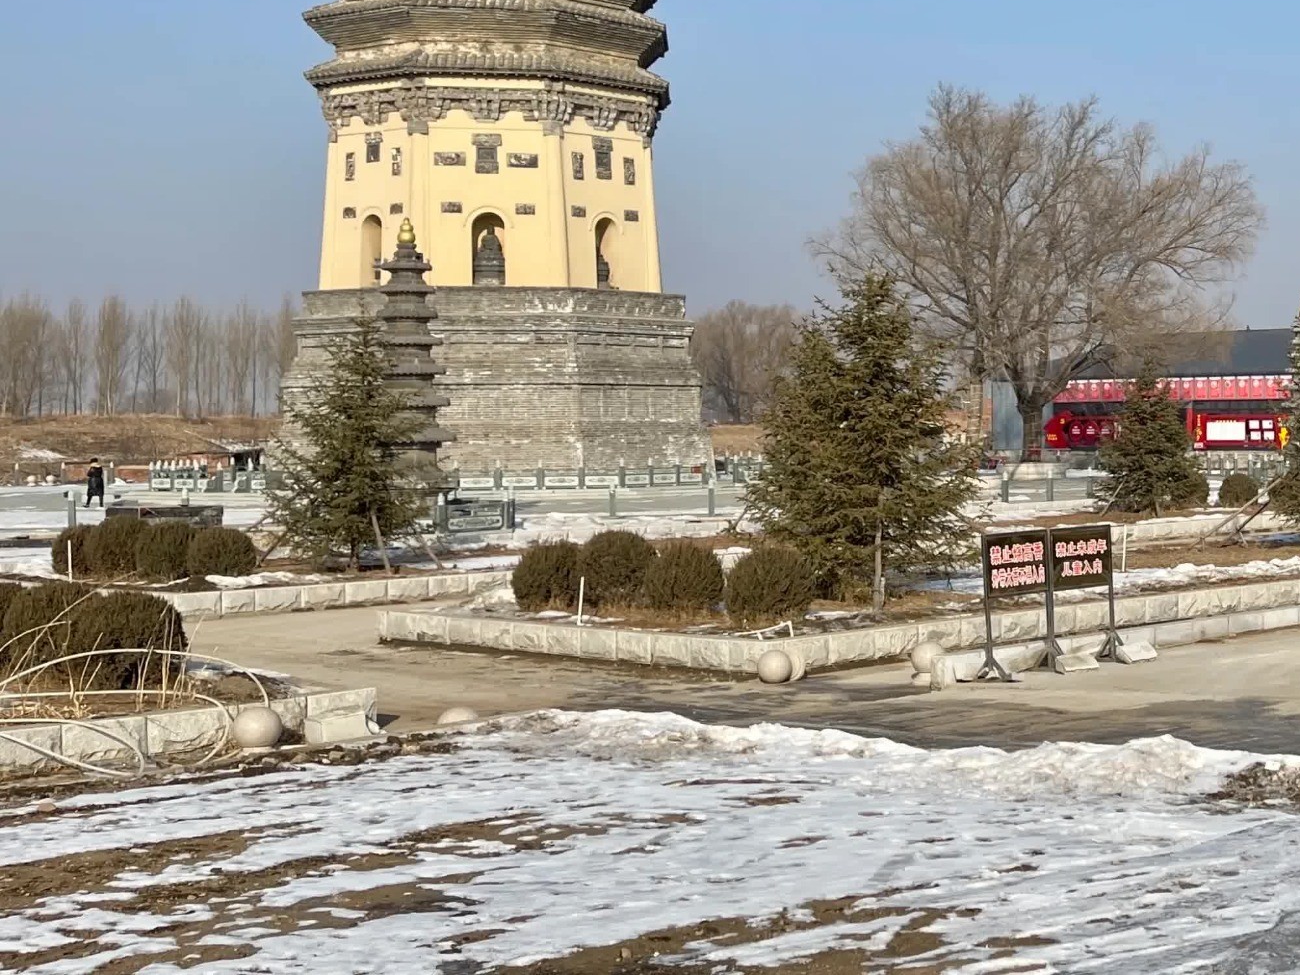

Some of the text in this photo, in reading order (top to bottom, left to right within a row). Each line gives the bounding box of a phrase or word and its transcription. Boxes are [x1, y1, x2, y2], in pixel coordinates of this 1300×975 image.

[990, 541, 1044, 566] 禁止烧高香
[1055, 538, 1107, 558] 禁止未成年
[1061, 558, 1103, 577] 儿童入内
